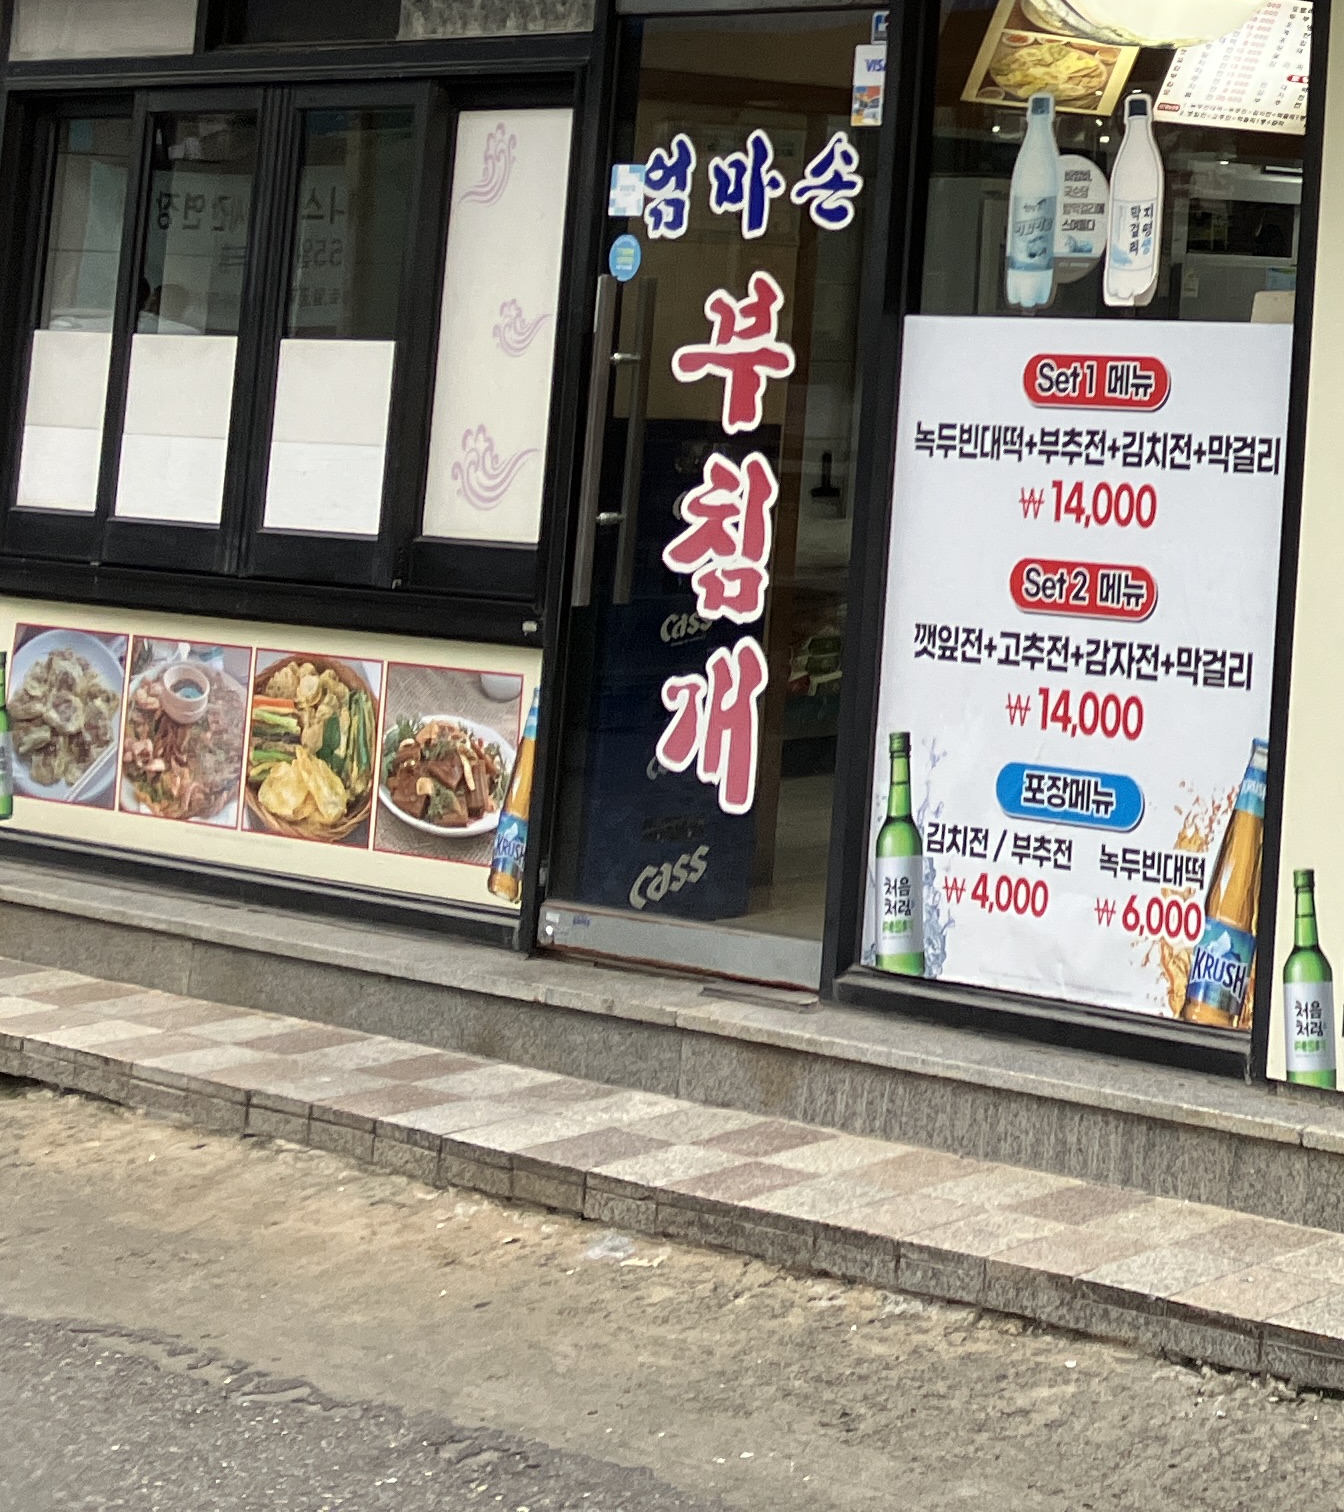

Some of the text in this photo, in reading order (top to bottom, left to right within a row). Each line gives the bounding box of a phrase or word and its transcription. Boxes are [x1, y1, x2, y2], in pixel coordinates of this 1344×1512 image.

[643, 129, 864, 239] 엄마손
[1106, 362, 1156, 400] 메뉴
[656, 271, 795, 814] 부침개
[1098, 570, 1147, 608] 메뉴
[1021, 772, 1116, 818] 포장메뉴
[926, 821, 989, 860] 김치전
[1011, 831, 1073, 871] 부추전
[1099, 843, 1206, 889] 녹두빈대떡
[628, 845, 710, 909] Cass
[884, 876, 911, 898] 처음
[884, 898, 912, 917] 처럼
[1193, 949, 1248, 999] KRUSH
[1295, 1000, 1322, 1019] 처음
[1296, 1020, 1323, 1037] 처럼
